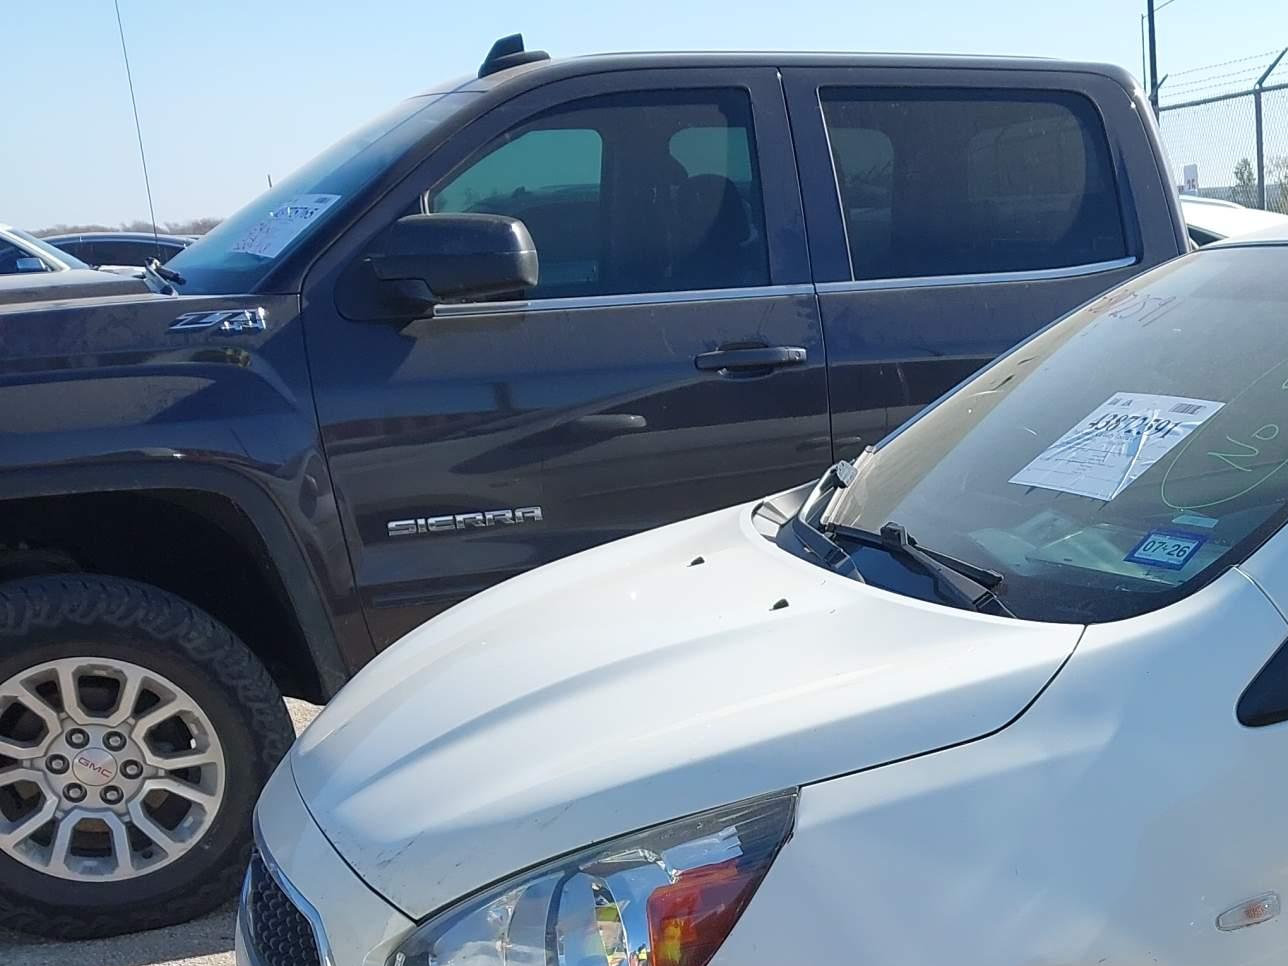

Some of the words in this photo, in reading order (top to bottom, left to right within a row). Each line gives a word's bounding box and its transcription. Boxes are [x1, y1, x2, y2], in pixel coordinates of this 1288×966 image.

[1207, 423, 1280, 472] No
[386, 505, 544, 537] SIERRA
[78, 756, 113, 778] GMC
